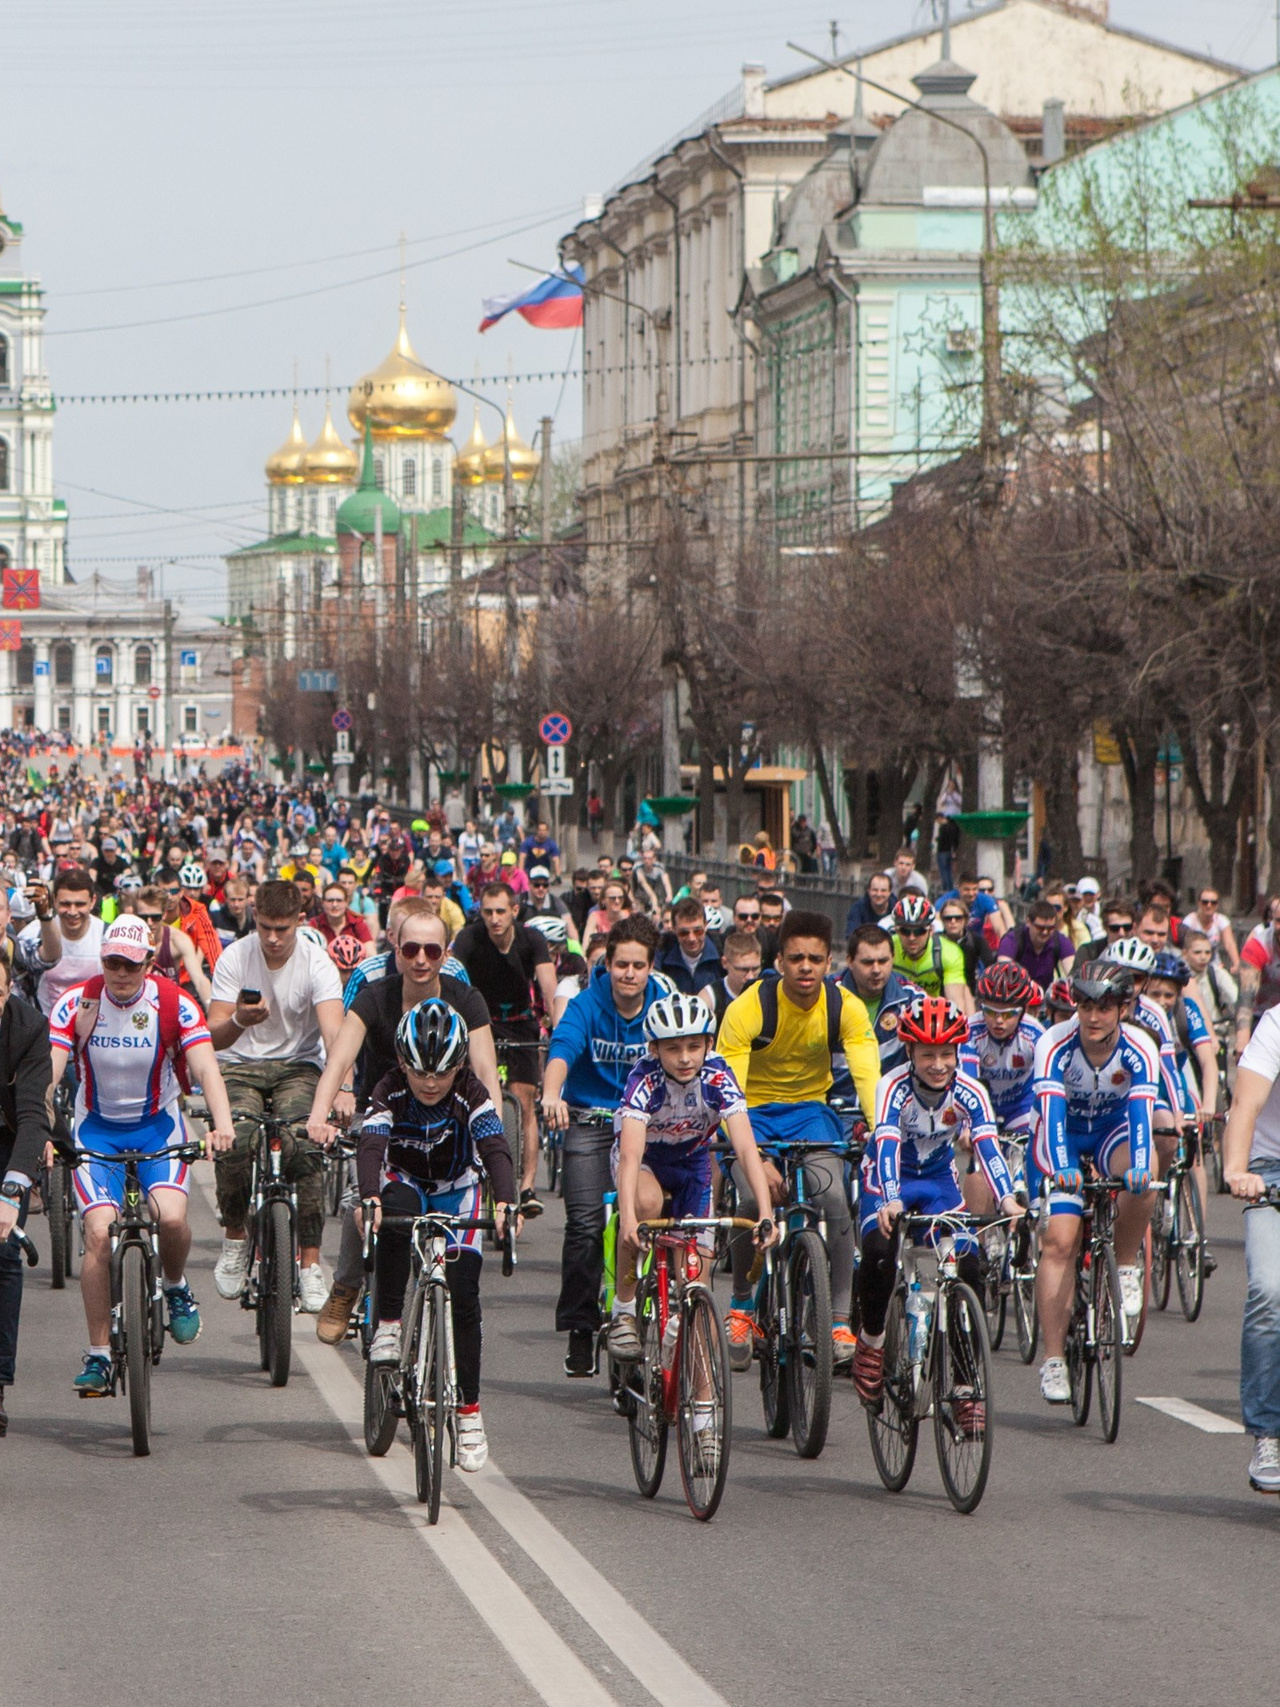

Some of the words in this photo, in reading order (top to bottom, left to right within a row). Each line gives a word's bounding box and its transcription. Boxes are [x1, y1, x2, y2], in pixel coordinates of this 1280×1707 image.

[109, 926, 143, 943] RUSSIA
[1139, 1008, 1161, 1031] PRO
[90, 1035, 152, 1048] RUSSIA
[1122, 1050, 1143, 1073] PRO
[953, 1085, 978, 1110] PRO
